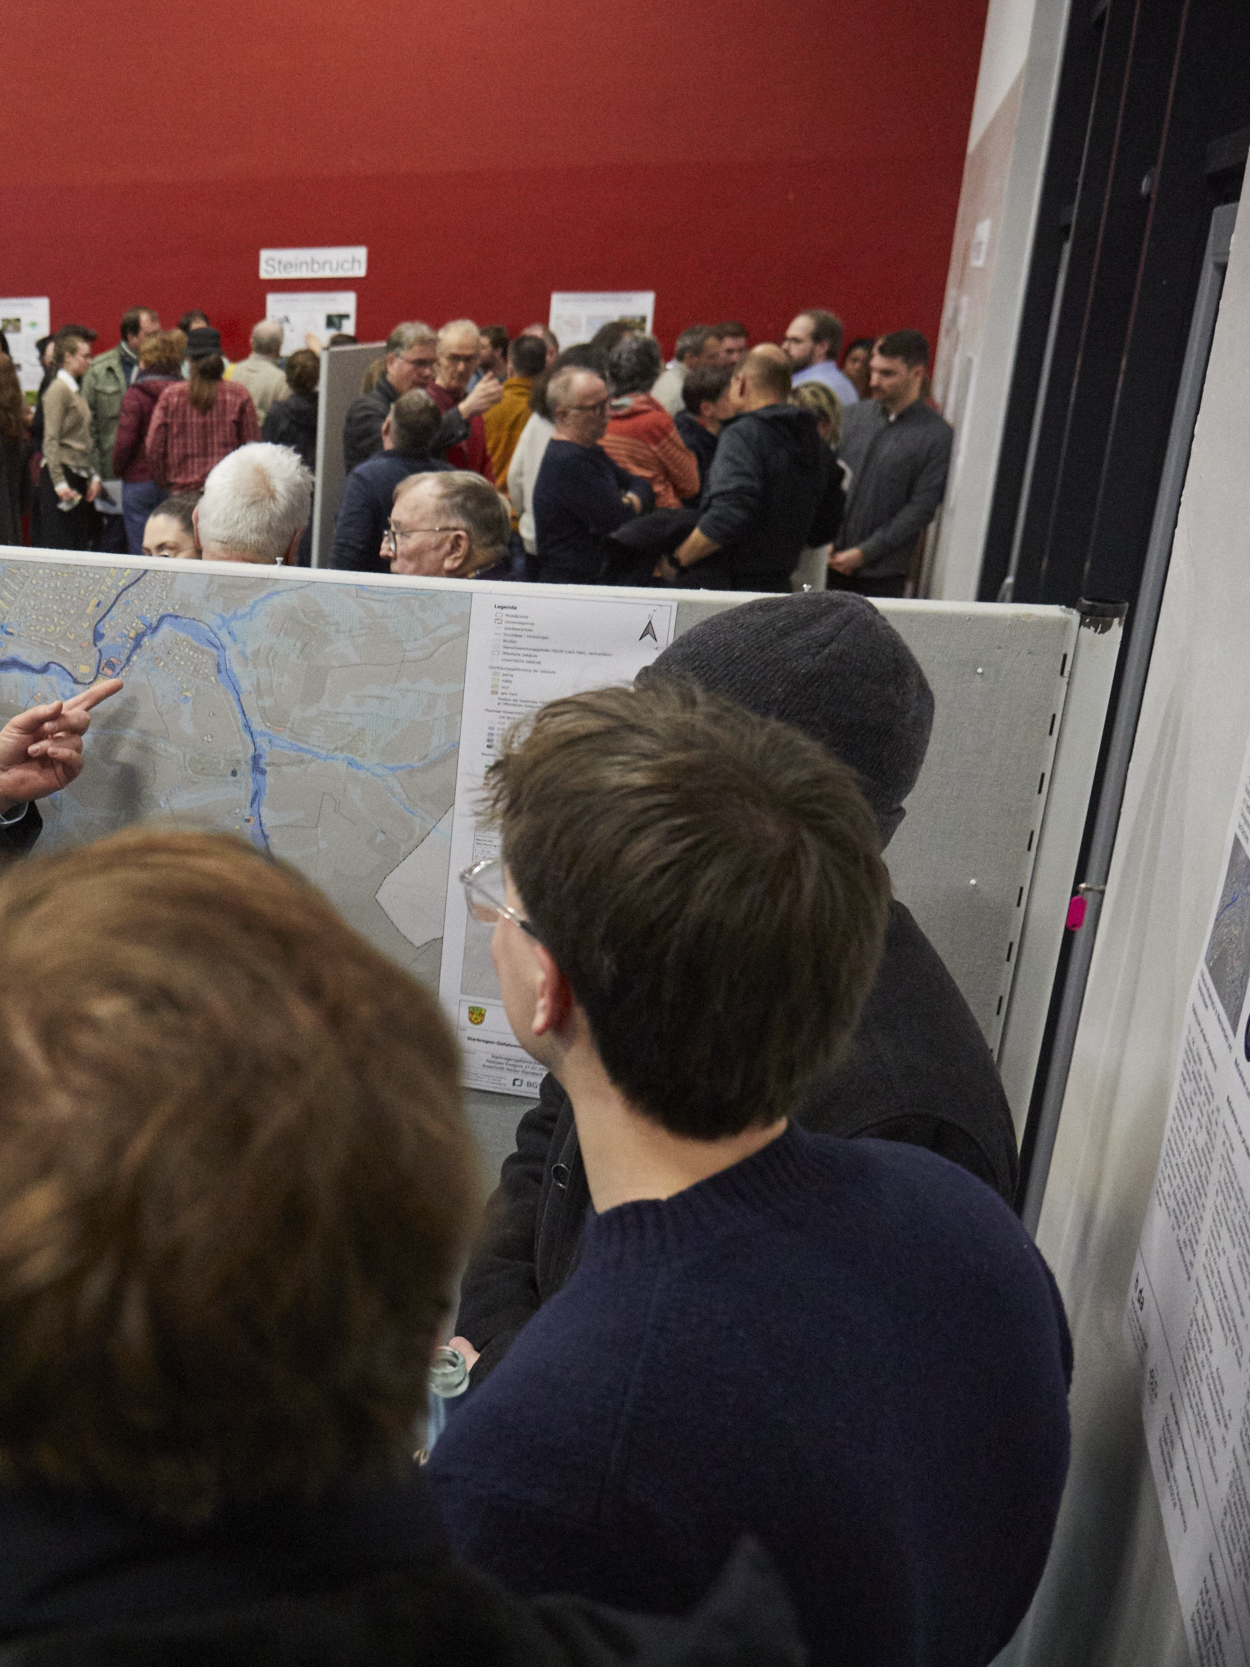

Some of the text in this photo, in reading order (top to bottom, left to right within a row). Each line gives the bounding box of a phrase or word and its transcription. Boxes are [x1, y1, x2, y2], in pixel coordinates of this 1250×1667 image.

[264, 255, 362, 274] Steinbruch
[467, 1036, 521, 1048] Starkregen-Gefahren
[526, 1081, 538, 1089] BG
